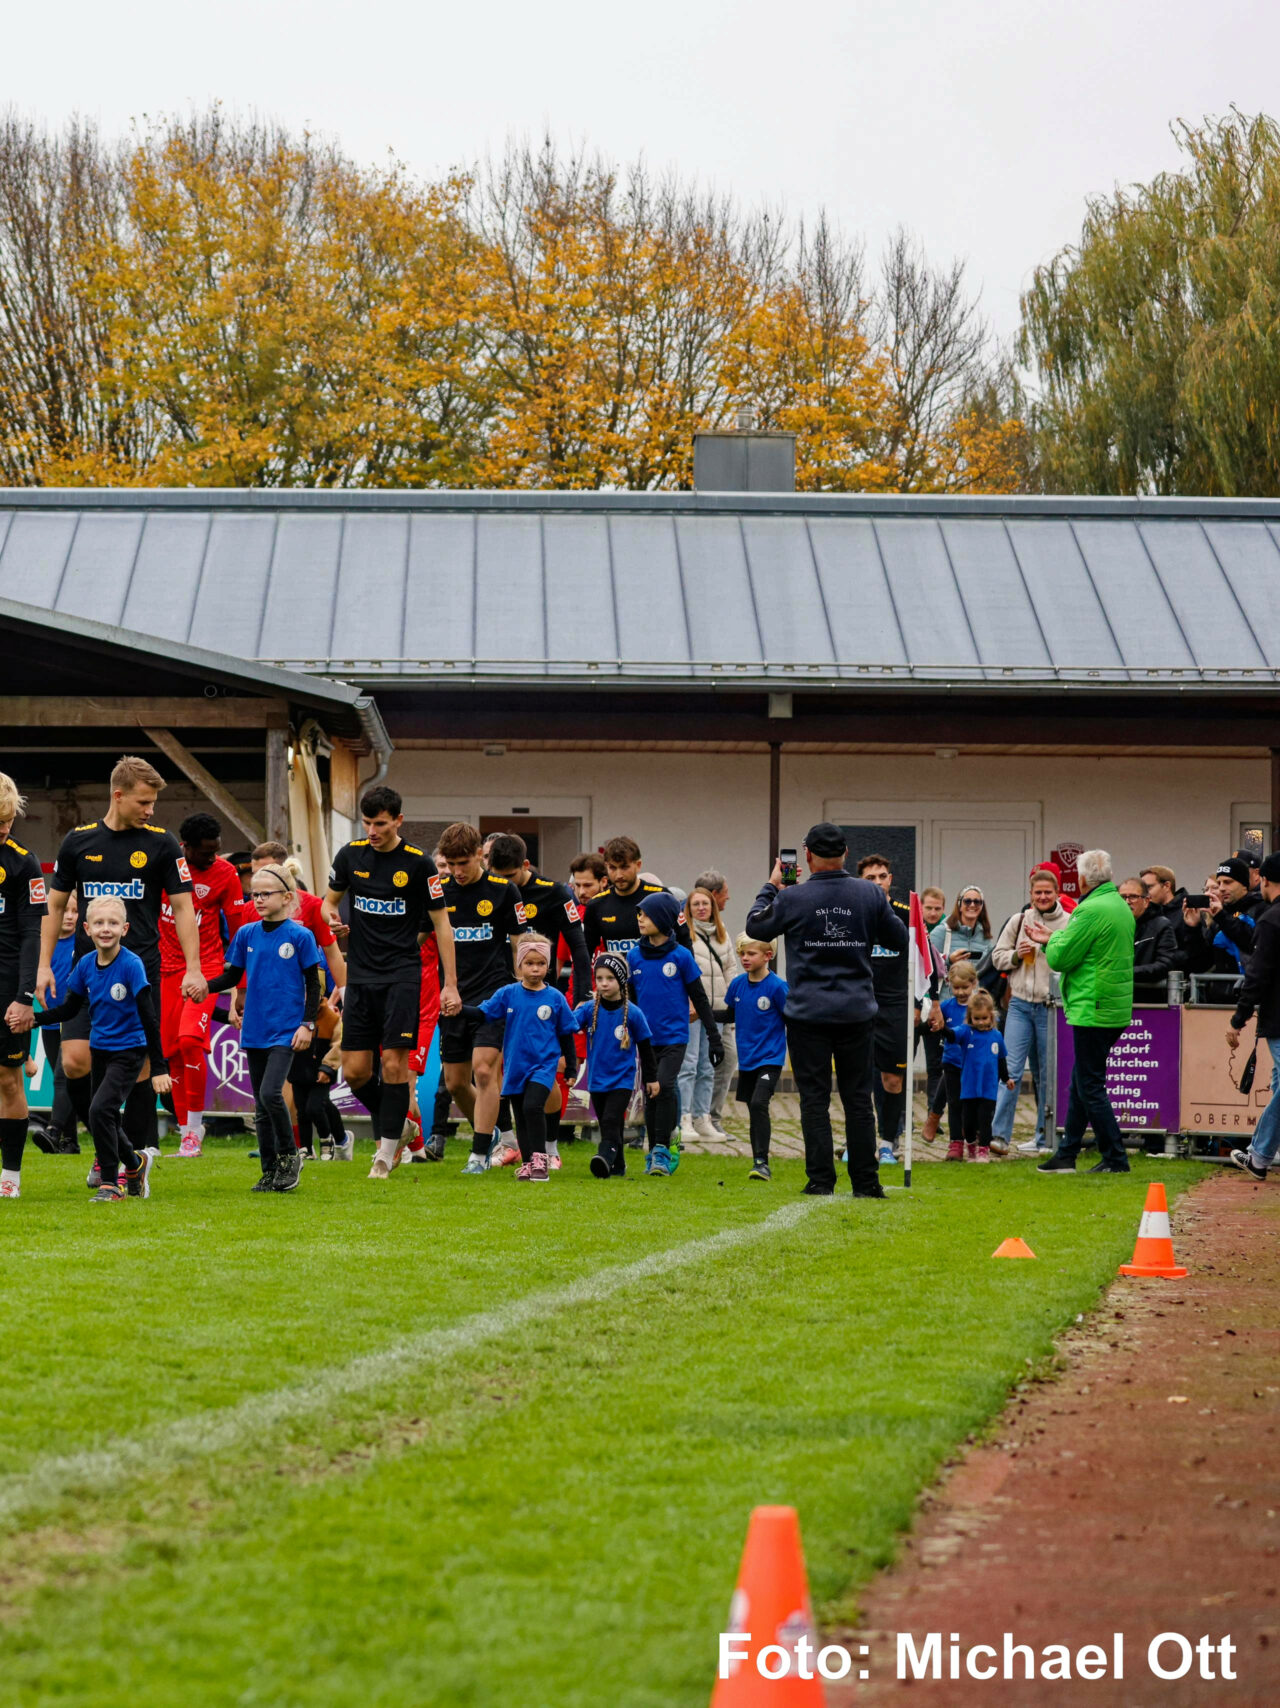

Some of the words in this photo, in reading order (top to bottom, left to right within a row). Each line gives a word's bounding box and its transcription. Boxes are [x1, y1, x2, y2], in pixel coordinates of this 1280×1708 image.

[83, 878, 145, 899] maxit
[354, 895, 406, 915] maxit
[815, 906, 852, 916] Ski-Club
[606, 938, 640, 953] max
[804, 940, 867, 948] Niedertaufkirchen
[1106, 1057, 1159, 1068] fkirchen
[1106, 1072, 1148, 1081] rstern
[1104, 1085, 1141, 1098] rding
[1111, 1099, 1159, 1109] enheim
[1114, 1112, 1147, 1125] ofing
[1194, 1112, 1257, 1126] OBERM
